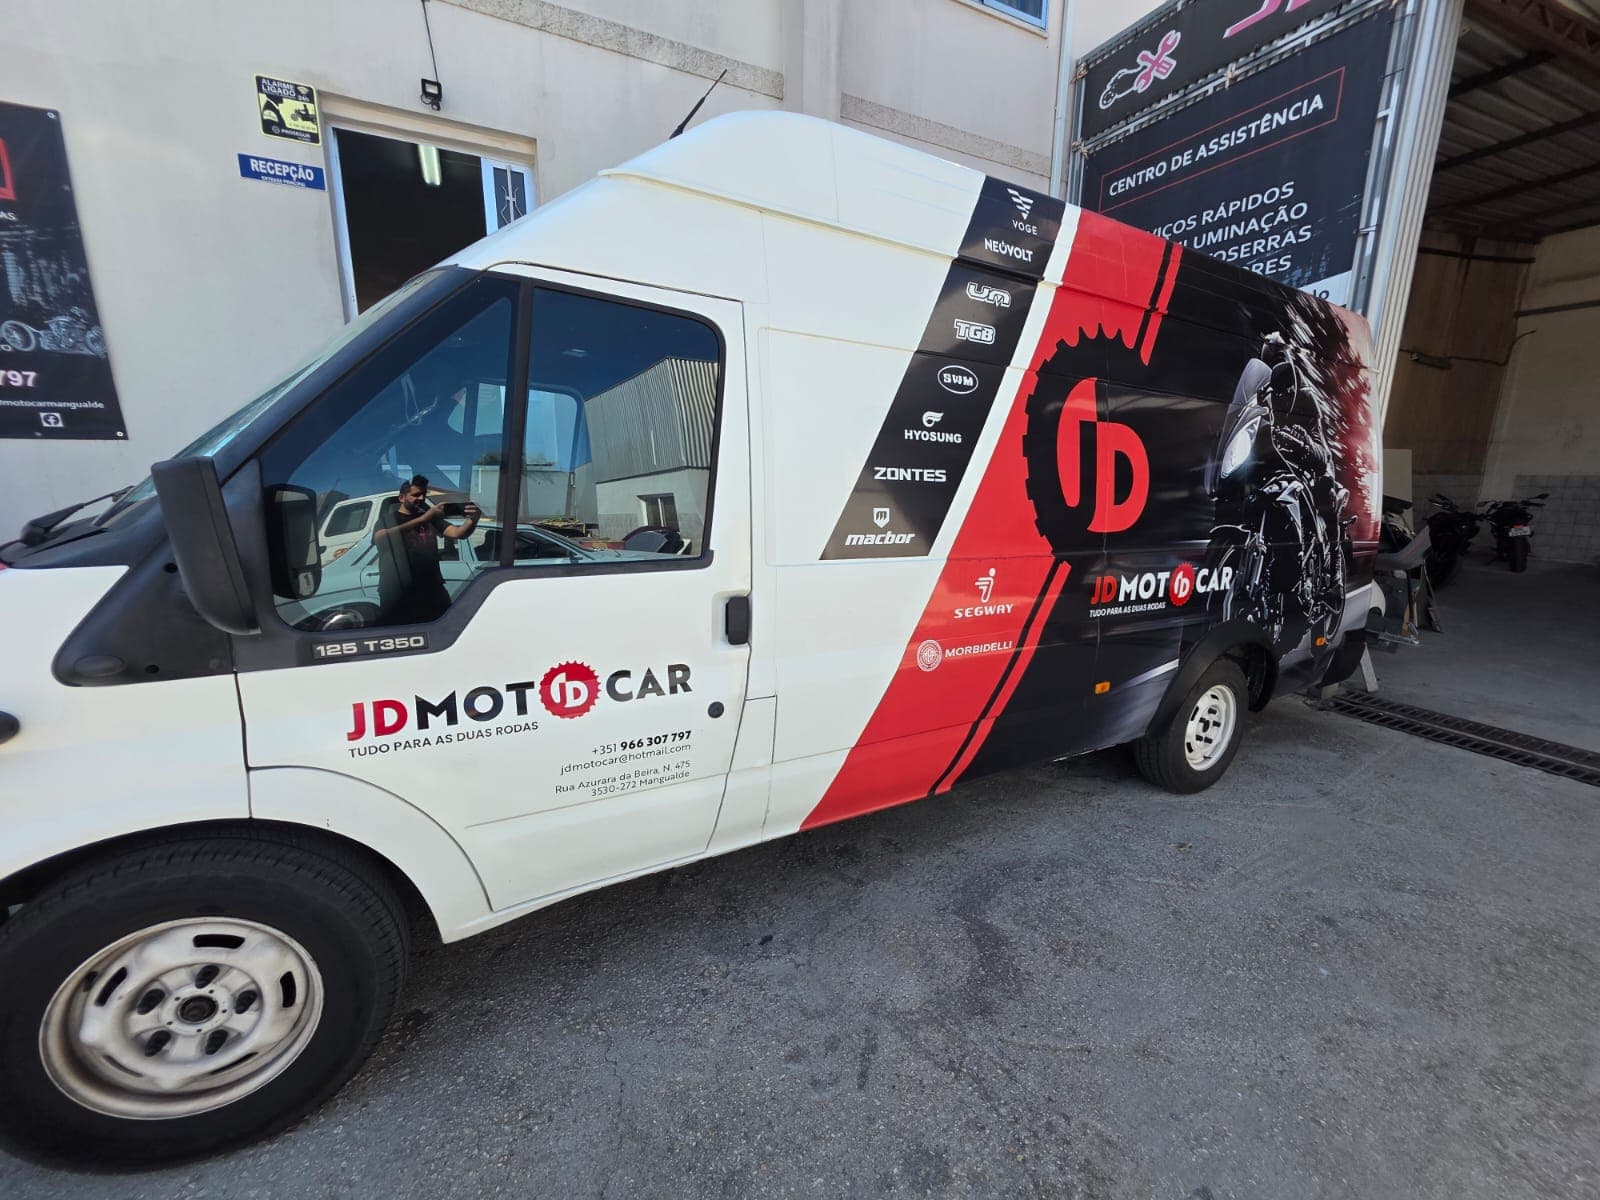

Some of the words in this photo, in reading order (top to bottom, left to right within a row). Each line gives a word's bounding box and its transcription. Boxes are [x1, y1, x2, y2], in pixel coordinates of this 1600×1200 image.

[261, 85, 296, 97] LIGADO
[262, 78, 294, 91] ALARME
[1109, 161, 1167, 196] CENTRO
[1170, 149, 1193, 172] DE
[1195, 94, 1325, 162] ASSISTÊNCIA
[249, 158, 314, 181] RECEPÇÃO
[1201, 181, 1295, 225] RÁPIDOS
[1012, 219, 1038, 235] VOGE
[954, 319, 995, 345] TGB
[943, 372, 974, 386] SWM
[904, 429, 962, 443] HYOSUNG
[874, 467, 947, 482] ZONTES
[845, 531, 915, 546] macbor
[954, 603, 1014, 619] SEGWAY
[1089, 608, 1106, 618] TUDO
[1106, 605, 1122, 616] PARA
[1122, 604, 1132, 613] AS
[315, 642, 358, 657] 125
[364, 636, 425, 652] T350
[945, 640, 1012, 658] MORBIDELLI
[349, 743, 390, 758] TUDO
[394, 737, 432, 751] PARA
[435, 733, 453, 745] AS
[457, 728, 492, 742] DUAS
[496, 721, 538, 736] RODAS
[592, 743, 617, 755] +351
[620, 738, 643, 751] 966
[646, 734, 668, 747] 307
[671, 730, 692, 743] 797
[560, 743, 691, 776] jdmotocar@hotmail.com
[555, 783, 575, 794] Rua
[578, 775, 617, 790] Azurara
[619, 771, 632, 781] da
[675, 760, 691, 770] 475
[591, 779, 637, 797] 3530-272
[639, 770, 690, 787] Mangualde
